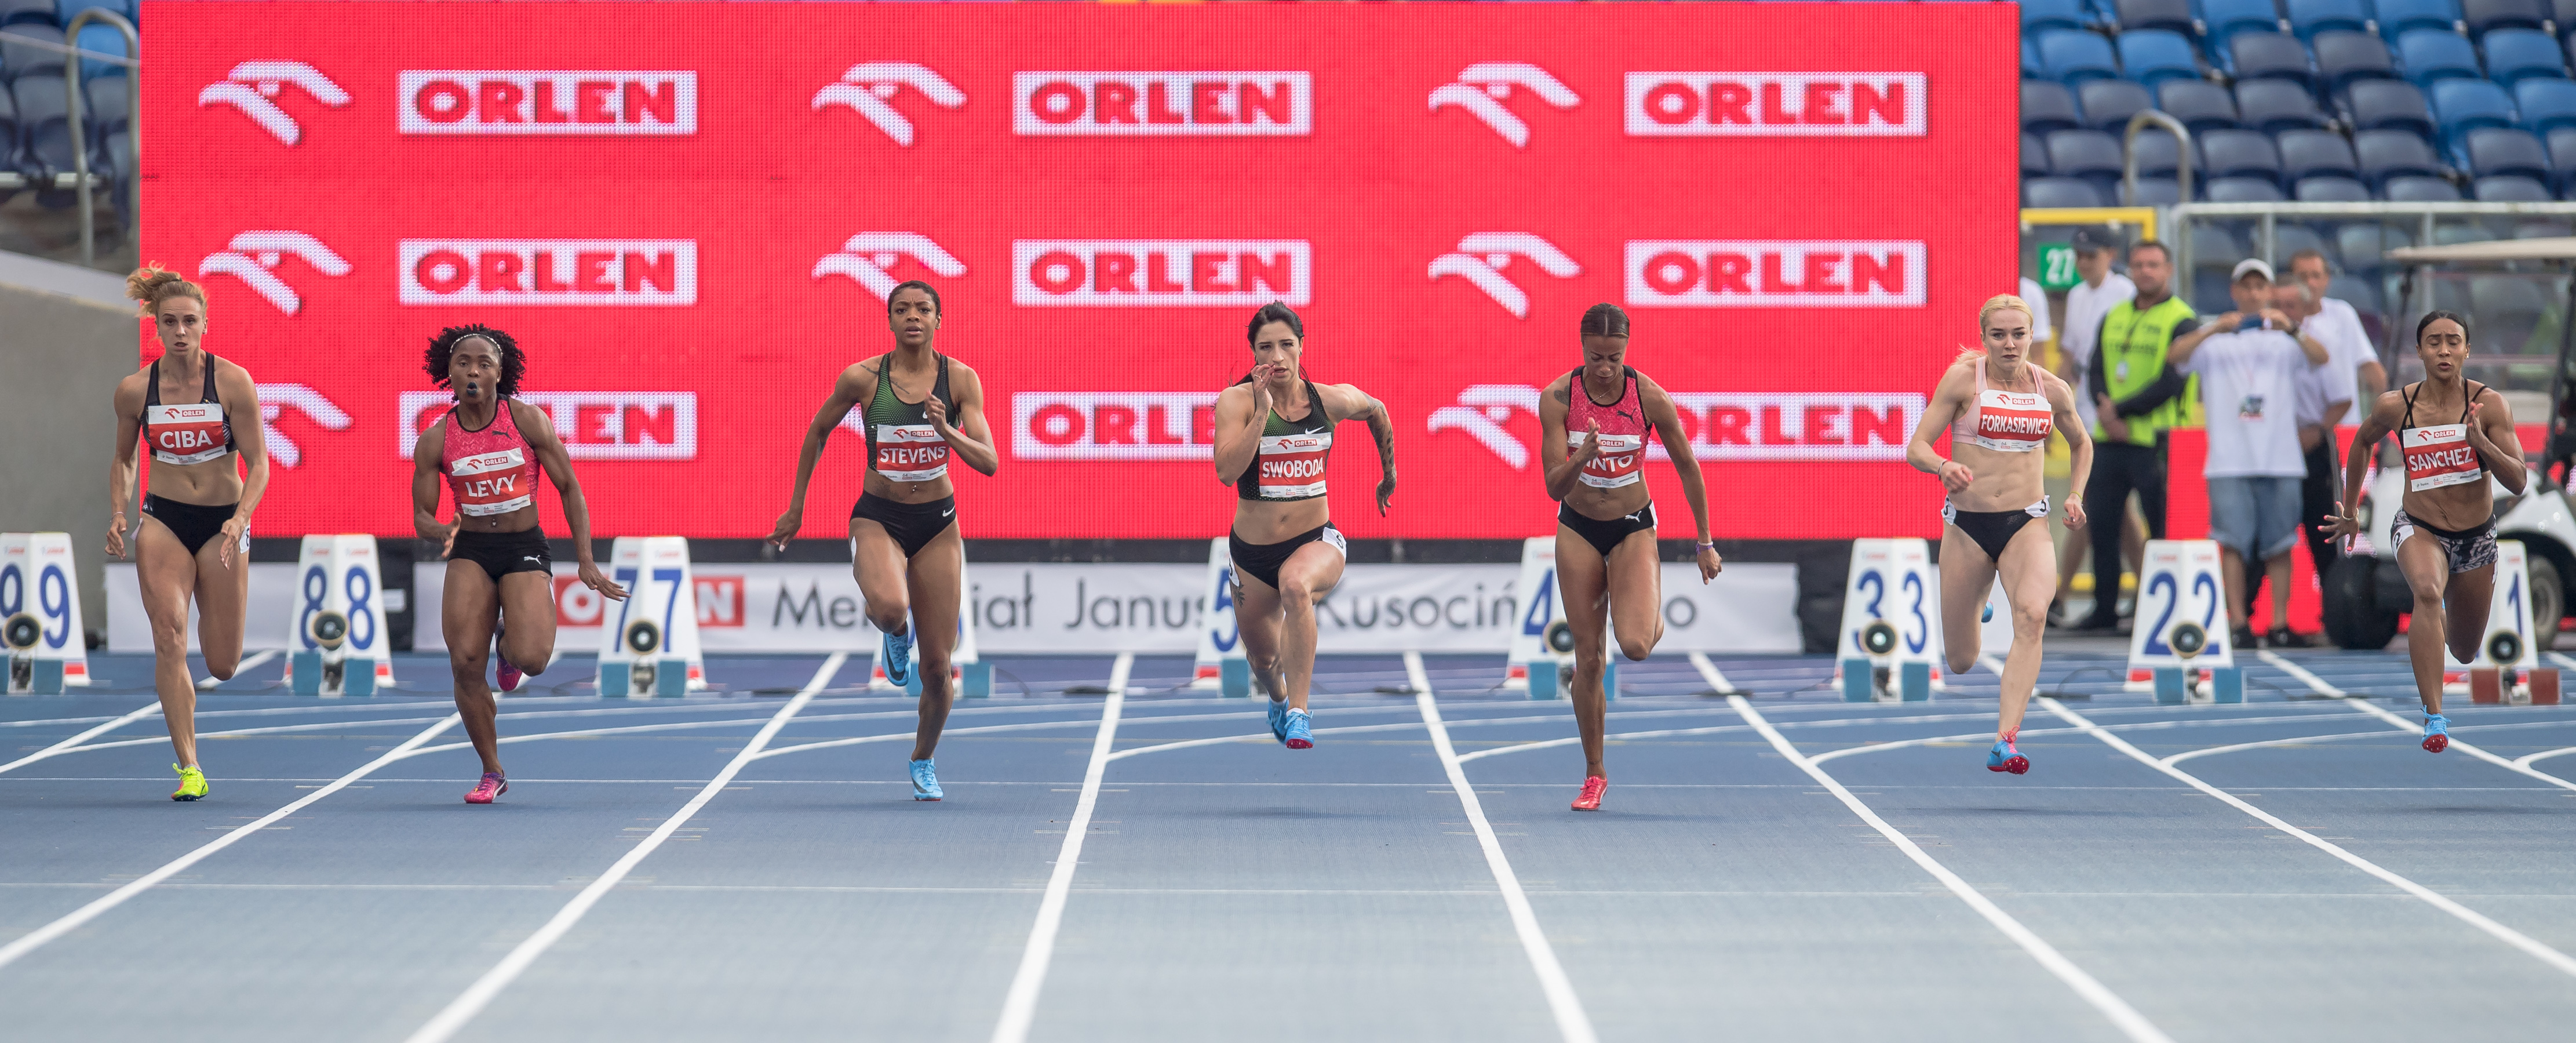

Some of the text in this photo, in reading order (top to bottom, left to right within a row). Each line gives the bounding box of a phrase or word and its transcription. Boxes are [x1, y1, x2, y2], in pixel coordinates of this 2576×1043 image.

[417, 81, 675, 123] ORLEN
[1030, 82, 1291, 123] ORLEN
[1644, 82, 1904, 125] ORLEN
[417, 251, 675, 295] ORLEN
[1030, 252, 1291, 295] ORLEN
[1644, 252, 1904, 296] ORLEN
[2046, 247, 2076, 285] 27
[160, 430, 213, 448] CIBA
[1030, 404, 1215, 446] ORLE
[1981, 414, 2049, 435] FORKASIEWICZ
[485, 457, 507, 466] ORLEN
[880, 446, 946, 464] STEVENS
[1262, 457, 1324, 478] SWOBODA
[1586, 455, 1634, 473] INTO
[2409, 446, 2473, 472] SANCHEZ
[465, 473, 517, 497] LEVY
[2394, 532, 2403, 550] 2
[39, 564, 70, 649] 9
[345, 566, 374, 650] 8
[614, 568, 637, 652] 7
[653, 568, 682, 652] 7
[1212, 568, 1238, 652] 5
[1524, 567, 1553, 652] 4
[1903, 570, 1927, 654] 3
[2143, 571, 2177, 655] 2
[2194, 572, 2220, 655] 2
[2507, 572, 2523, 635] 1
